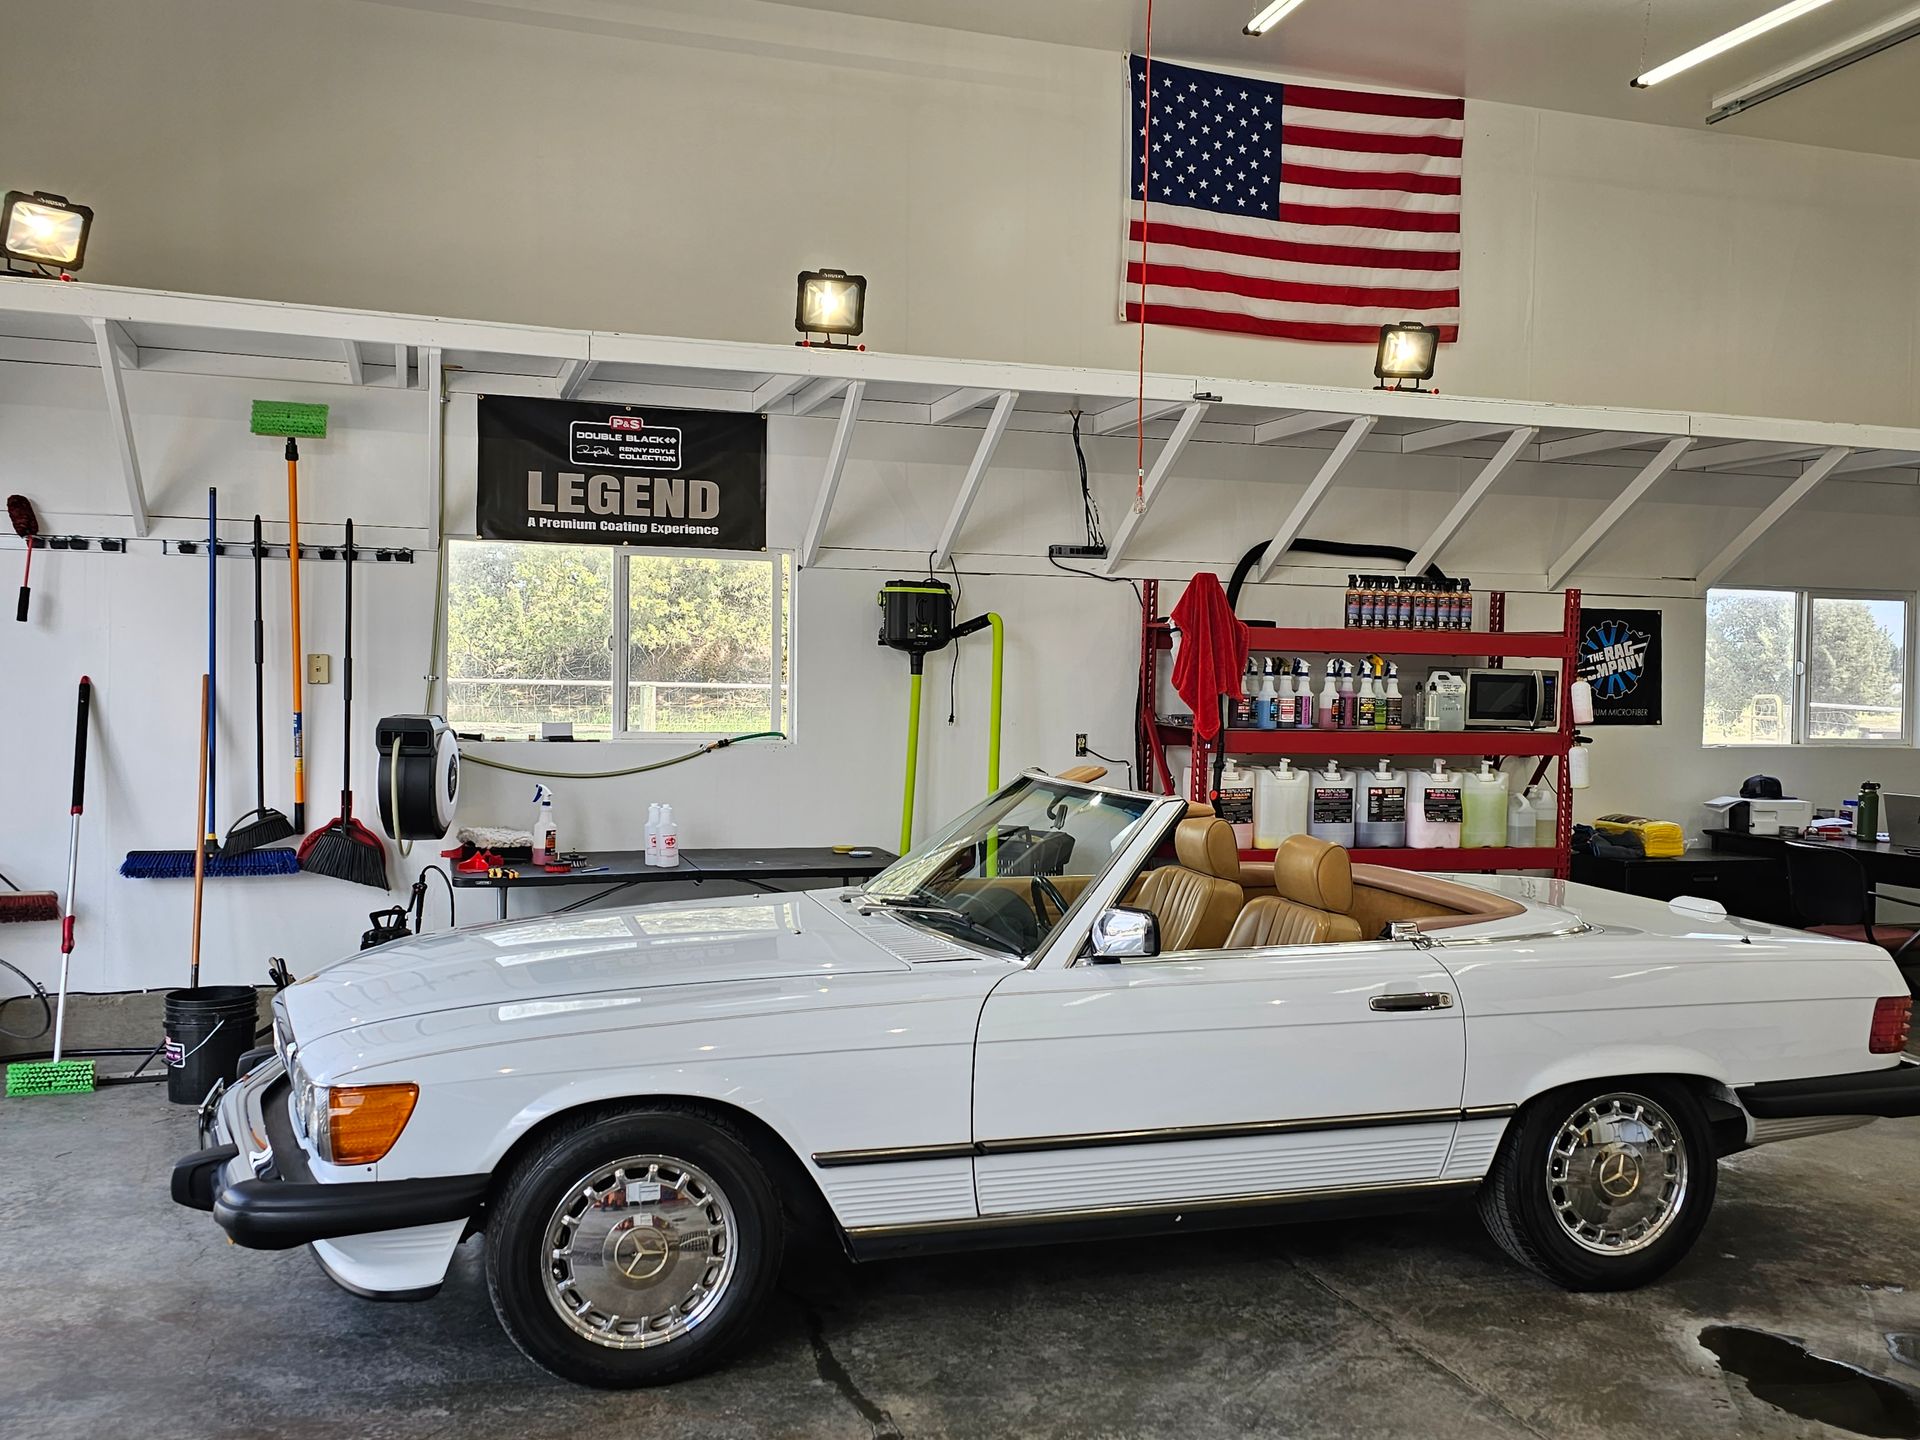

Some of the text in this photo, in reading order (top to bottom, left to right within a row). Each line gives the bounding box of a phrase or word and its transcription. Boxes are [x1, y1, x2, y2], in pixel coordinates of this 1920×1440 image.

[612, 418, 640, 430] P&S
[576, 431, 664, 444] DOUBLE BLACK
[619, 446, 648, 454] RENNY
[619, 453, 676, 462] COLLECTION
[527, 470, 720, 520] LEGEND
[527, 517, 720, 535] A Premium Coating Experience
[1586, 640, 1647, 663] THE RAG
[1607, 708, 1648, 717] MICROFIBER
